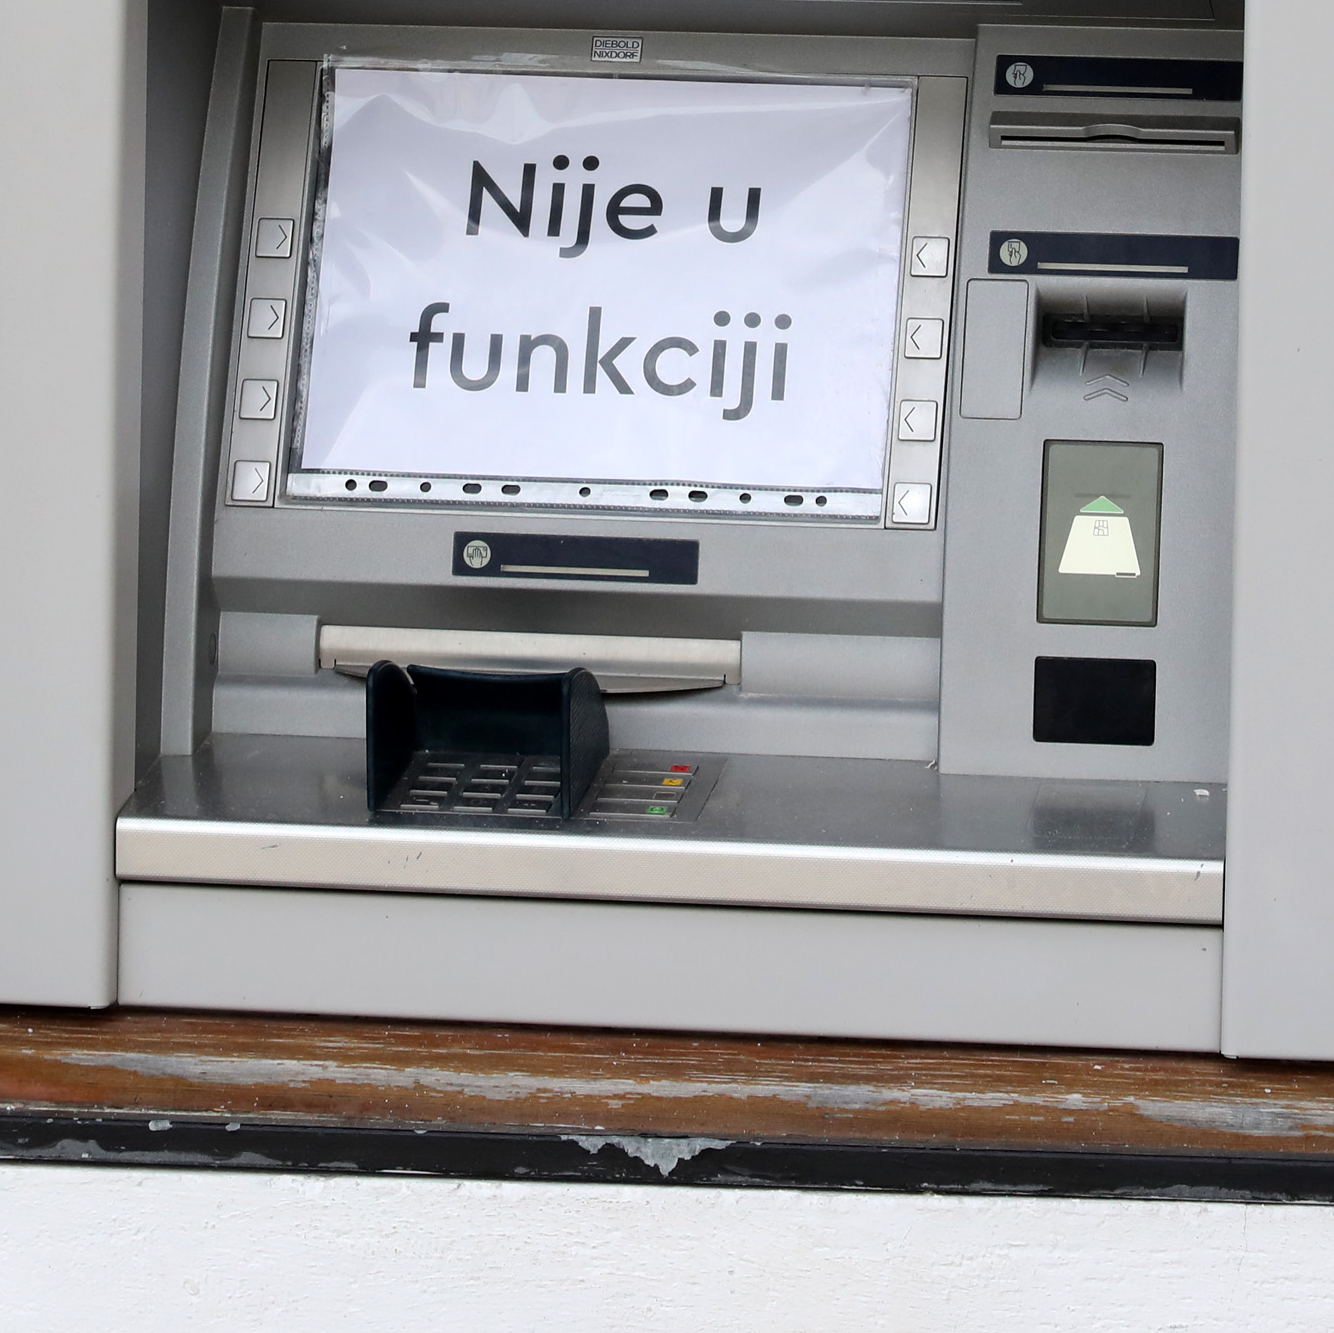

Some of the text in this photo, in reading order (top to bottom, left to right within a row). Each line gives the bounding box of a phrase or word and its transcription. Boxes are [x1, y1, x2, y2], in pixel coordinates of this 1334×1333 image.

[593, 50, 639, 60] NIXDORF
[595, 39, 640, 49] DIEBOLD
[465, 154, 762, 259] Nije u
[409, 302, 793, 422] funkciji
